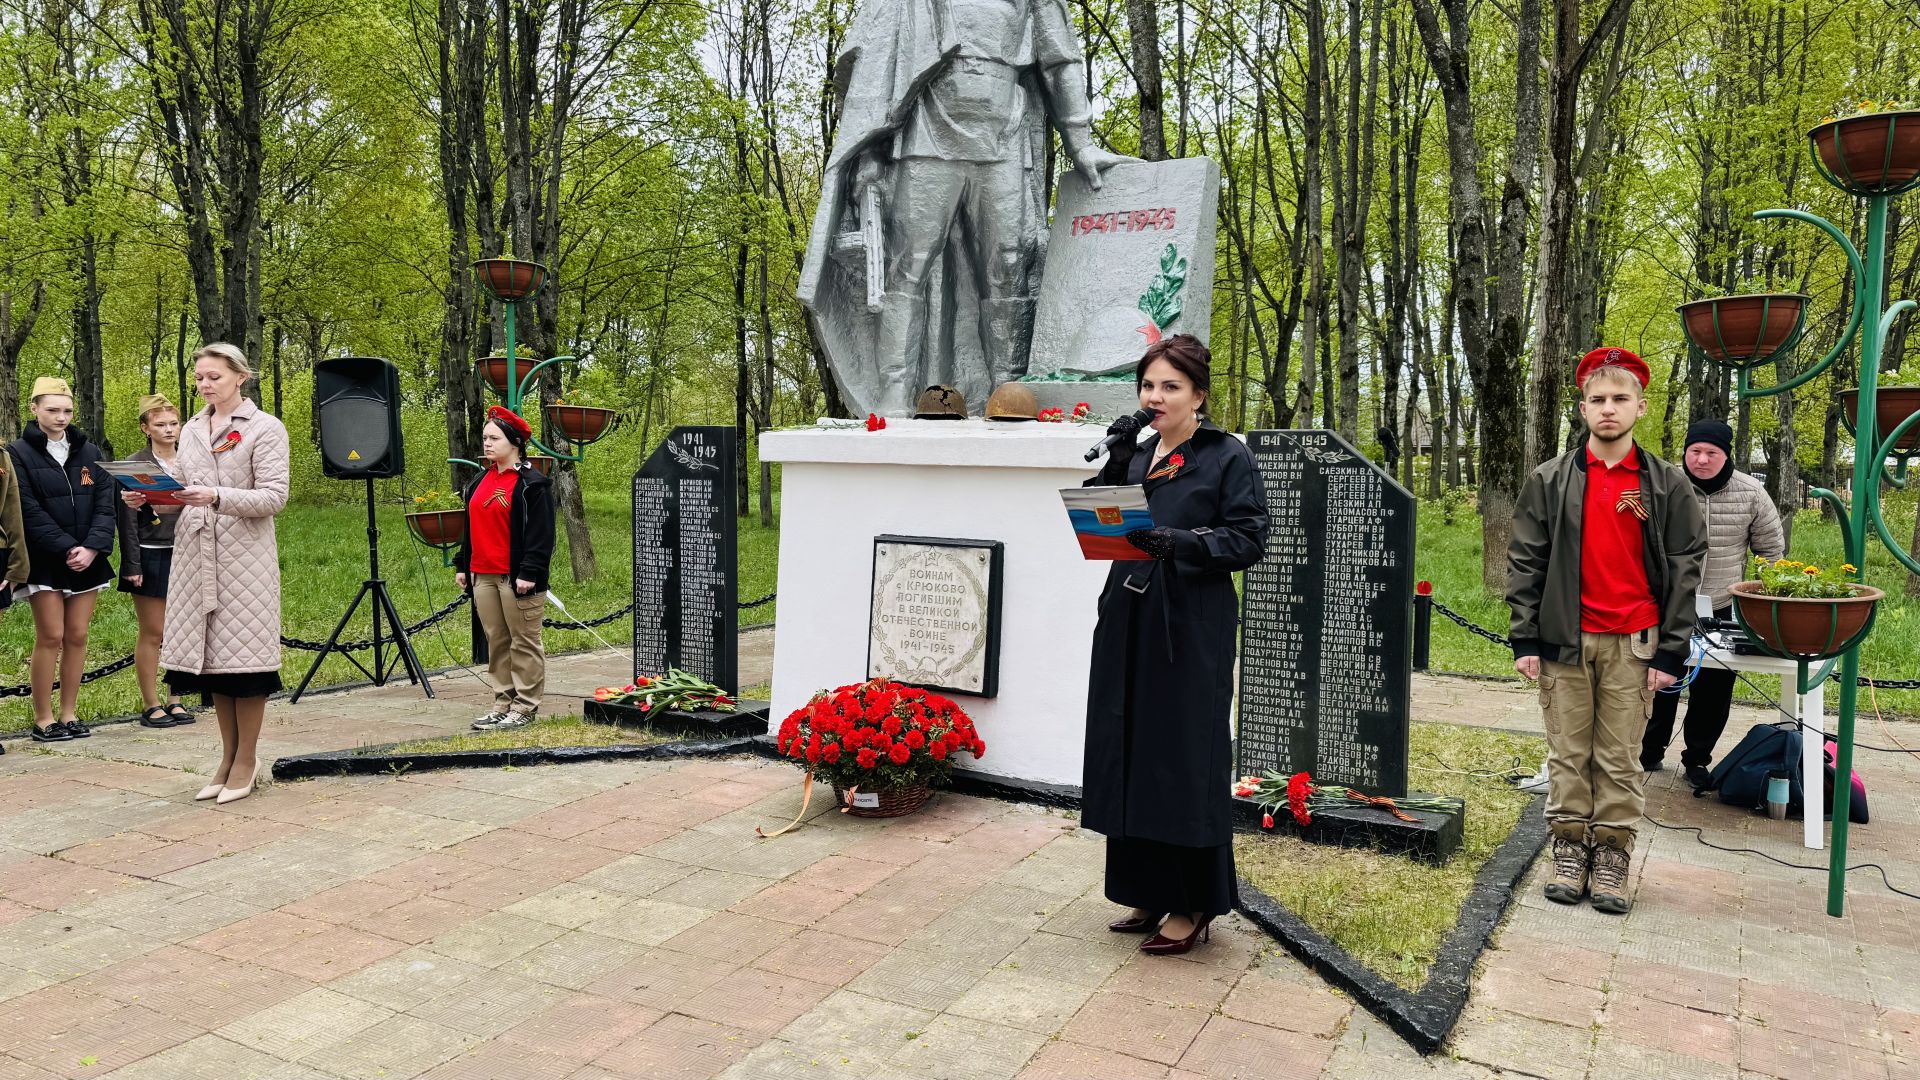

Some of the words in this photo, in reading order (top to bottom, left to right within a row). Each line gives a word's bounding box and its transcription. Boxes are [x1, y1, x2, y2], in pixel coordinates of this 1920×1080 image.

[1072, 208, 1176, 236] 1941-1945
[683, 433, 703, 444] 1941
[1261, 436, 1280, 445] 1941
[1302, 435, 1327, 445] 1945
[694, 446, 716, 458] 1945
[1327, 508, 1377, 516] СОЛОМАСОВ
[1327, 516, 1364, 524] СТАРЦЕВ
[1326, 524, 1369, 532] СУББОТИН
[1326, 532, 1363, 540] СУХАРЕВ
[1326, 540, 1363, 549] СУХАРЕВ
[1325, 548, 1380, 557] ТАТАРНИКОВ
[1325, 556, 1379, 566] ТАТАРНИКОВ
[1325, 564, 1351, 572] ТИТОВ
[910, 570, 953, 581] ВОИНАМ
[1248, 573, 1277, 582] ПАВЛОВ
[1324, 572, 1350, 580] ТИТОВ
[907, 581, 966, 594] КРЮКОВО
[1247, 583, 1277, 591] ПАВЛОВ
[1324, 580, 1370, 590] ТОЛМАЧЕВ
[1247, 592, 1287, 602] ПАДУРУЕВ
[1324, 588, 1362, 597] ТРУБКИН
[896, 592, 962, 606] ПОГИБШИМ
[1323, 596, 1354, 605] ТРУСОВ
[1247, 601, 1276, 610] ПАНКИН
[1324, 604, 1350, 612] ТУКОВ
[1246, 610, 1276, 620] ПАНКОВ
[1323, 612, 1356, 621] УХАНОВ
[1246, 620, 1284, 630] ПЕКУШЕВ
[1323, 620, 1357, 629] УШАКОВ
[1246, 629, 1287, 639] ПЕТРАКОВ
[1322, 628, 1366, 638] ФИЛИППОВ
[1245, 638, 1286, 649] ПОВАЛЯЕВ
[1321, 636, 1366, 646] ФИЛИППОВ
[1321, 643, 1348, 652] ЦУДИН
[1245, 648, 1286, 658] ПОДУРУЕВ
[1321, 651, 1365, 661] ФИЛИППОВ
[1245, 657, 1280, 667] ПОЛЕНОВ
[1320, 659, 1365, 670] ШЕВЛЯГИН
[1244, 667, 1290, 678] ПОТАТУРОВ
[1320, 667, 1370, 678] ШЕЛАГУРОВ
[1244, 676, 1280, 686] ПОЯРКОВ
[1320, 675, 1365, 686] ТОЛМАЧЕВ
[1244, 685, 1290, 697] ПРОСКУРОВ
[1320, 683, 1360, 693] ШЕПЕЛЕВ
[1243, 695, 1291, 707] ПРОСКУРОВ
[1320, 690, 1371, 702] ШЕЛАГУРОВ
[1243, 704, 1285, 716] ПРОХОРОВ
[1319, 707, 1343, 716] ЮЛИН
[1243, 714, 1289, 726] РАЗВЯЗКИН
[1319, 715, 1343, 724] ЮЛИН
[1243, 723, 1275, 733] РОЖКОВ
[1319, 723, 1343, 732] ЮЛИН
[1242, 731, 1275, 742] РОЖКОВ
[1319, 731, 1339, 740] ЯЗИН
[1242, 741, 1275, 751] РОЖКОВ
[1318, 739, 1361, 750] ЯСТРЕБОВ
[1242, 749, 1276, 760] РУСАКОВ
[1318, 747, 1361, 758] ЯСТРЕБОВ
[1242, 758, 1277, 770] САВРУЕВ
[1317, 755, 1349, 766] ГУДКОВ
[1317, 764, 1360, 776] СОЛУЯНОВ
[1317, 772, 1354, 784] СЕРГЕЕВ
